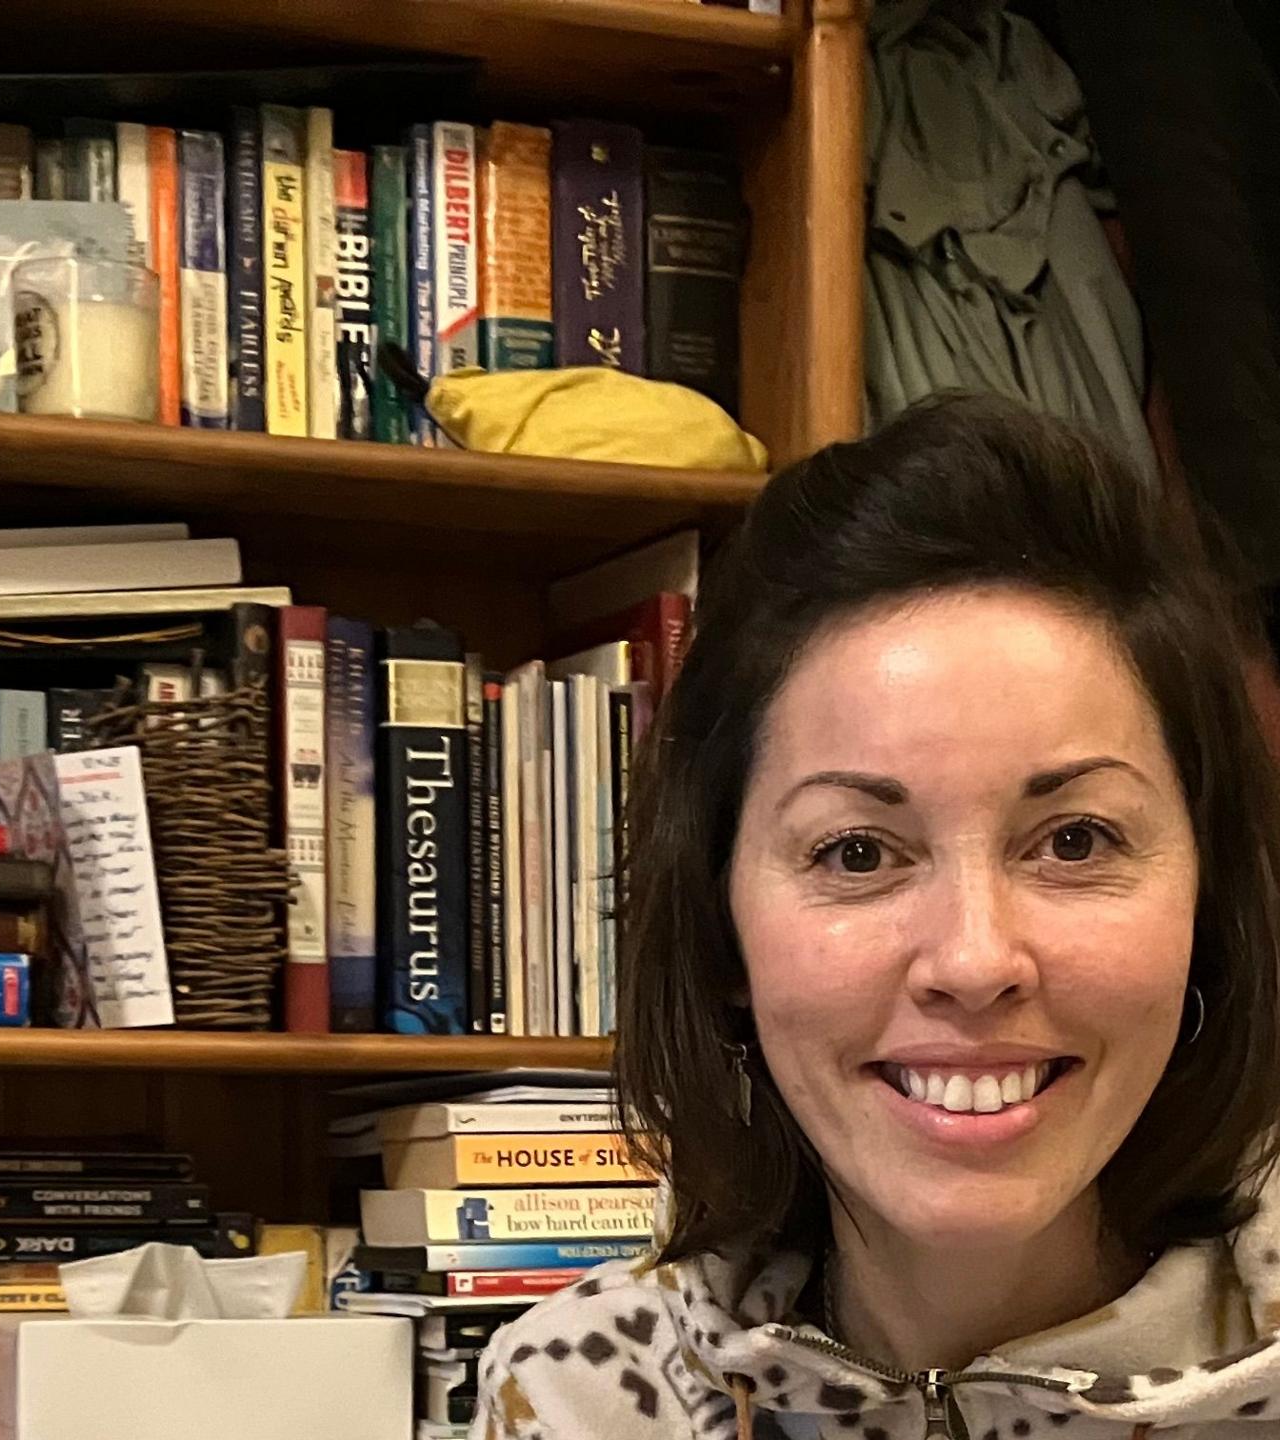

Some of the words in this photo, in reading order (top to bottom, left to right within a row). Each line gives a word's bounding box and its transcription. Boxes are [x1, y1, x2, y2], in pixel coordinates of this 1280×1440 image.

[276, 176, 298, 202] the
[446, 148, 471, 245] DILBERT
[271, 206, 300, 269] darwin
[415, 197, 431, 271] Marketing
[336, 234, 369, 344] BIBLE
[448, 244, 469, 310] PRINCIPLE
[417, 280, 431, 308] The
[239, 290, 261, 398] FEARLESS
[451, 348, 467, 370] SCO
[348, 646, 366, 735] KHALED
[488, 794, 502, 829] HIGH
[406, 736, 455, 1002] Thesaurus
[488, 832, 502, 898] WYCOMBE
[473, 1151, 493, 1166] The
[497, 1149, 575, 1169] HOUSE
[579, 1150, 591, 1166] of
[597, 1149, 631, 1168] SIL
[33, 1189, 152, 1203] CONVERSATIONS
[43, 1204, 80, 1217] WITH
[83, 1204, 143, 1217] FRIENDS
[514, 1191, 580, 1212] allison
[507, 1214, 544, 1233] how
[546, 1213, 589, 1233] hard
[591, 1216, 625, 1232] can
[626, 1213, 640, 1231] it
[15, 1236, 76, 1253] DARK
[557, 1244, 618, 1259] PERCEPTION
